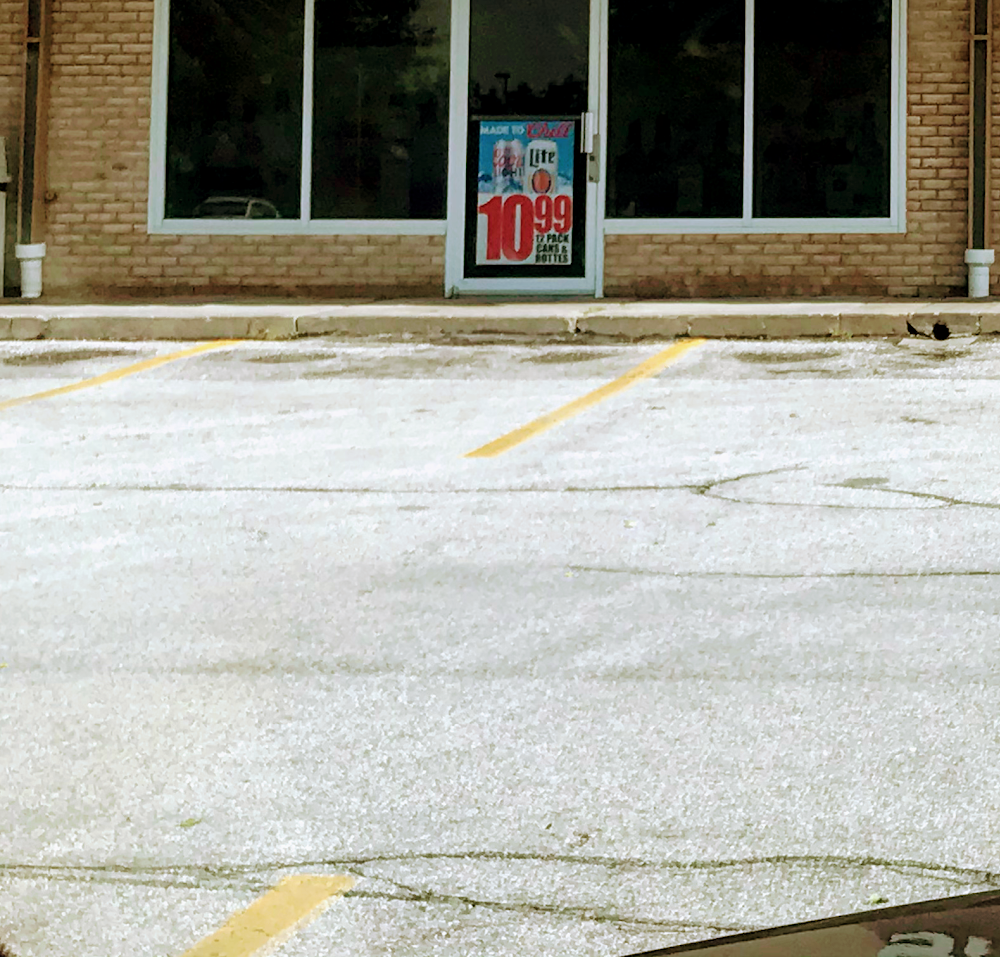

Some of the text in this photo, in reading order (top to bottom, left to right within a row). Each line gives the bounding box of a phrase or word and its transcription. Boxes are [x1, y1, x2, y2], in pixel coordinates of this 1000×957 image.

[511, 125, 525, 135] TO
[530, 149, 556, 168] Lite
[546, 233, 569, 243] PACK
[536, 244, 567, 254] CANS &
